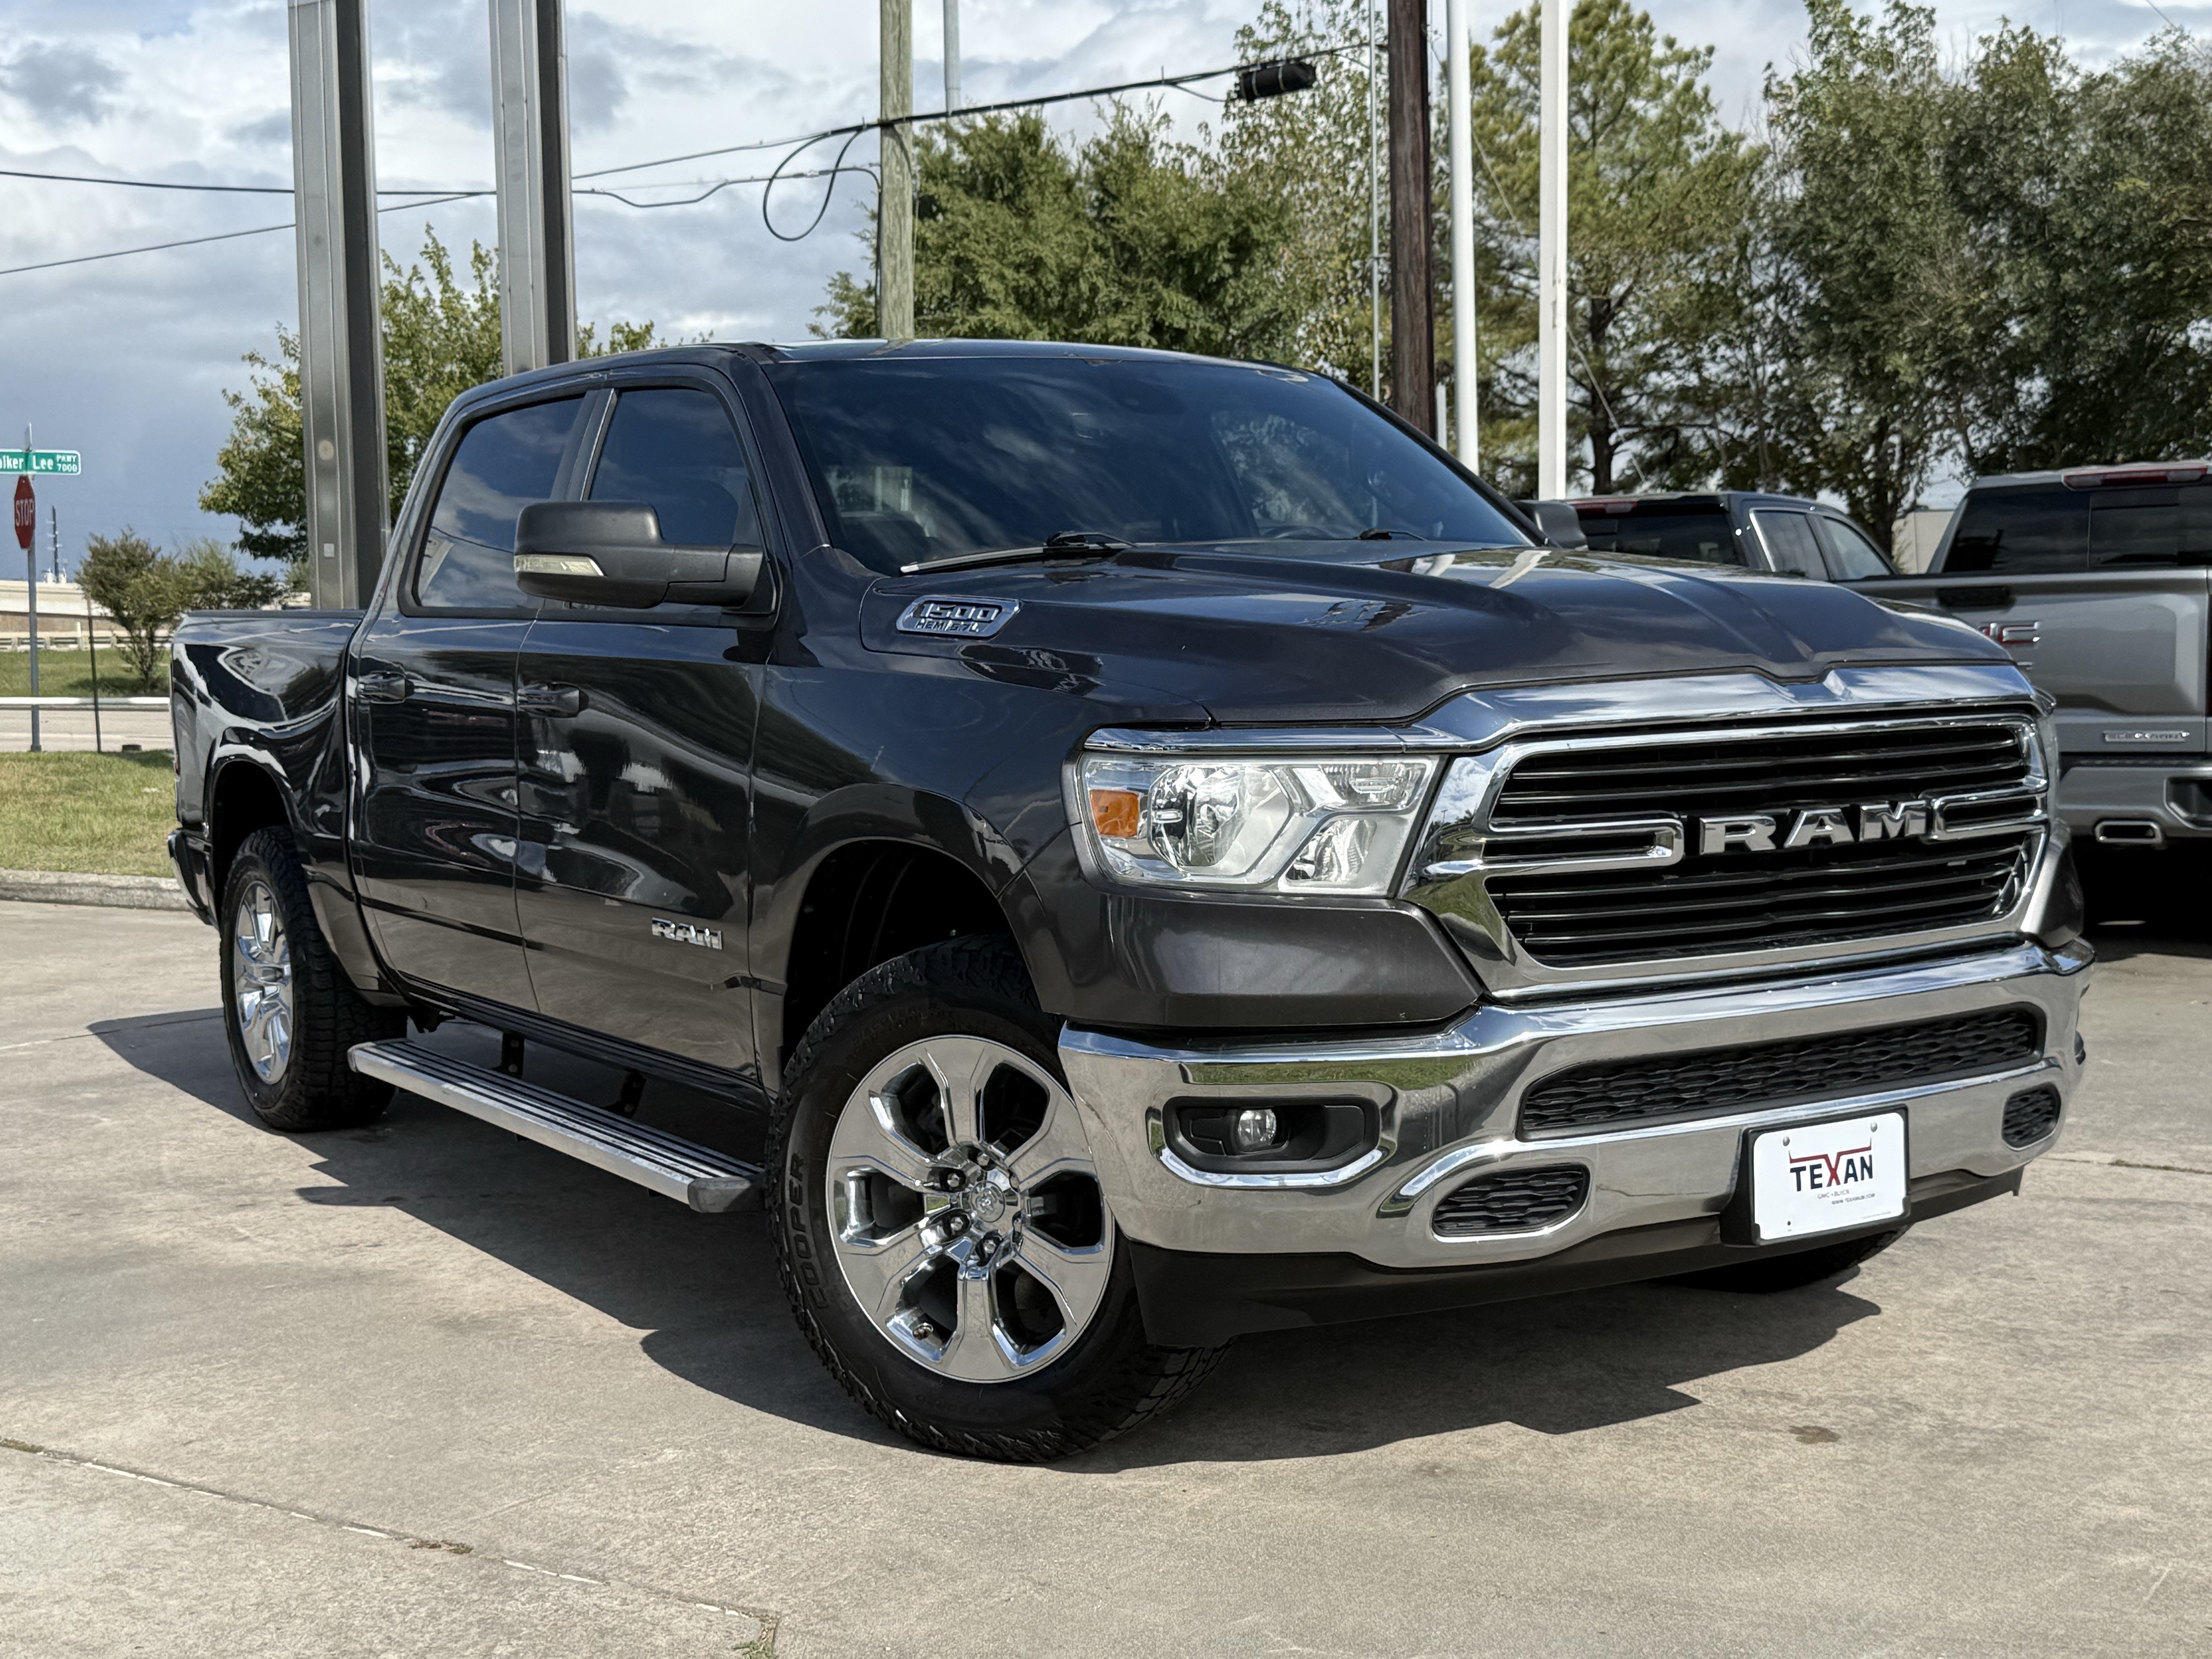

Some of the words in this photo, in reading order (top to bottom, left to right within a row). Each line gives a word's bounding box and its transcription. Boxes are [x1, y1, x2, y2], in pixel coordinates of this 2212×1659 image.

[33, 455, 53, 470] Lee
[57, 464, 77, 472] 7000
[15, 498, 34, 526] STOP
[914, 618, 953, 631] HEMI
[920, 603, 1000, 620] 1500
[1699, 800, 1926, 855] RAM
[652, 917, 722, 950] RAM
[1790, 1150, 1873, 1192] TEXAN
[789, 1152, 828, 1309] COOPER
